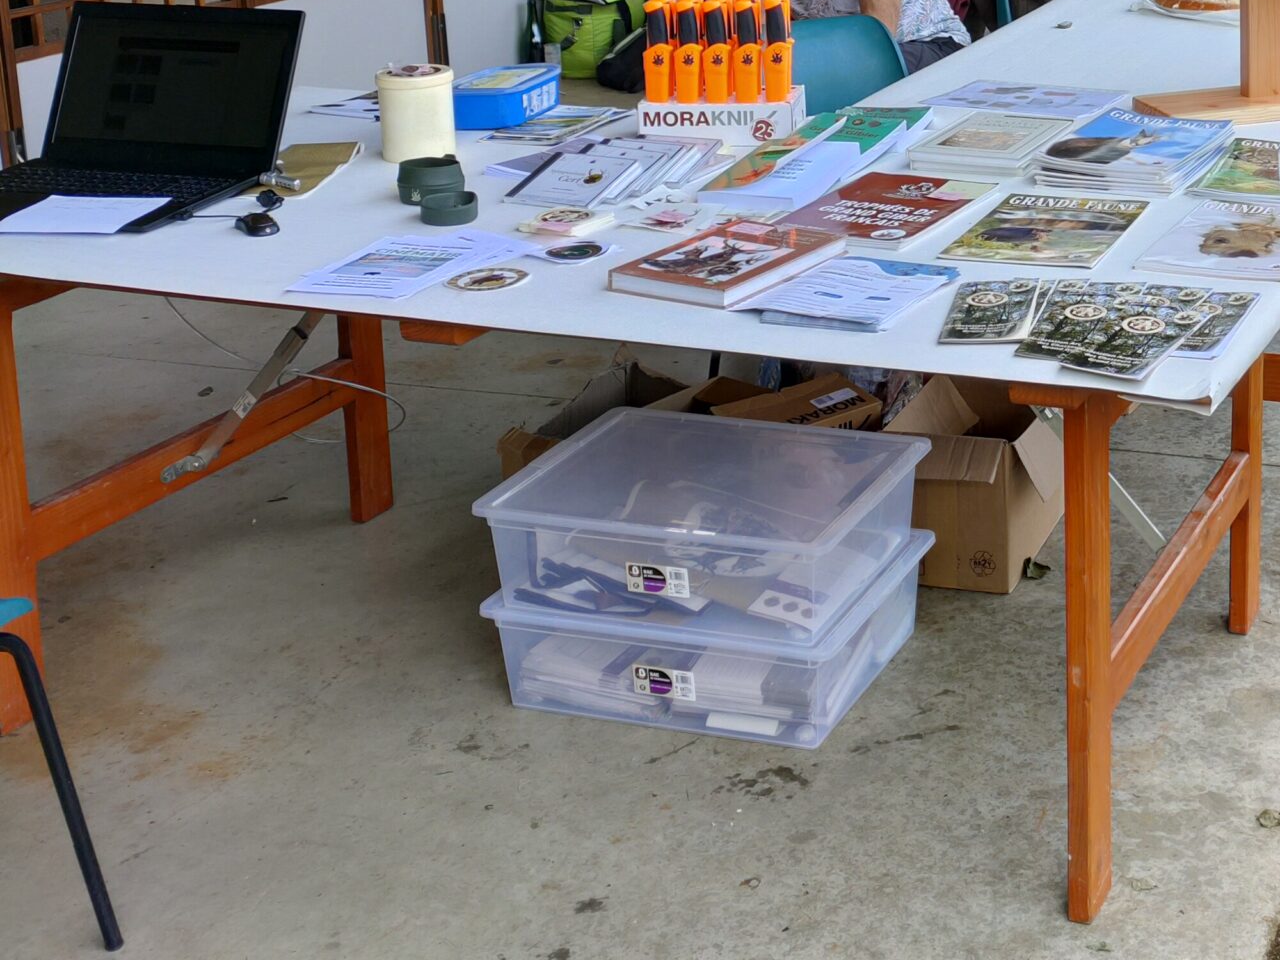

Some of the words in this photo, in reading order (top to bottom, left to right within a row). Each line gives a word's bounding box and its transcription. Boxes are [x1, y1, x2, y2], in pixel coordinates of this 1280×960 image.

[1109, 110, 1172, 128] GRANDE
[1172, 117, 1226, 130] FAUNE
[755, 122, 775, 139] 25
[835, 199, 915, 214] TROPHÉES
[913, 208, 940, 216] DE
[1008, 194, 1078, 209] GRANDE
[1082, 198, 1143, 213] FAUNE
[1202, 199, 1277, 216] GRANDE
[818, 205, 877, 217] GRAND
[877, 211, 932, 223] GIBIER
